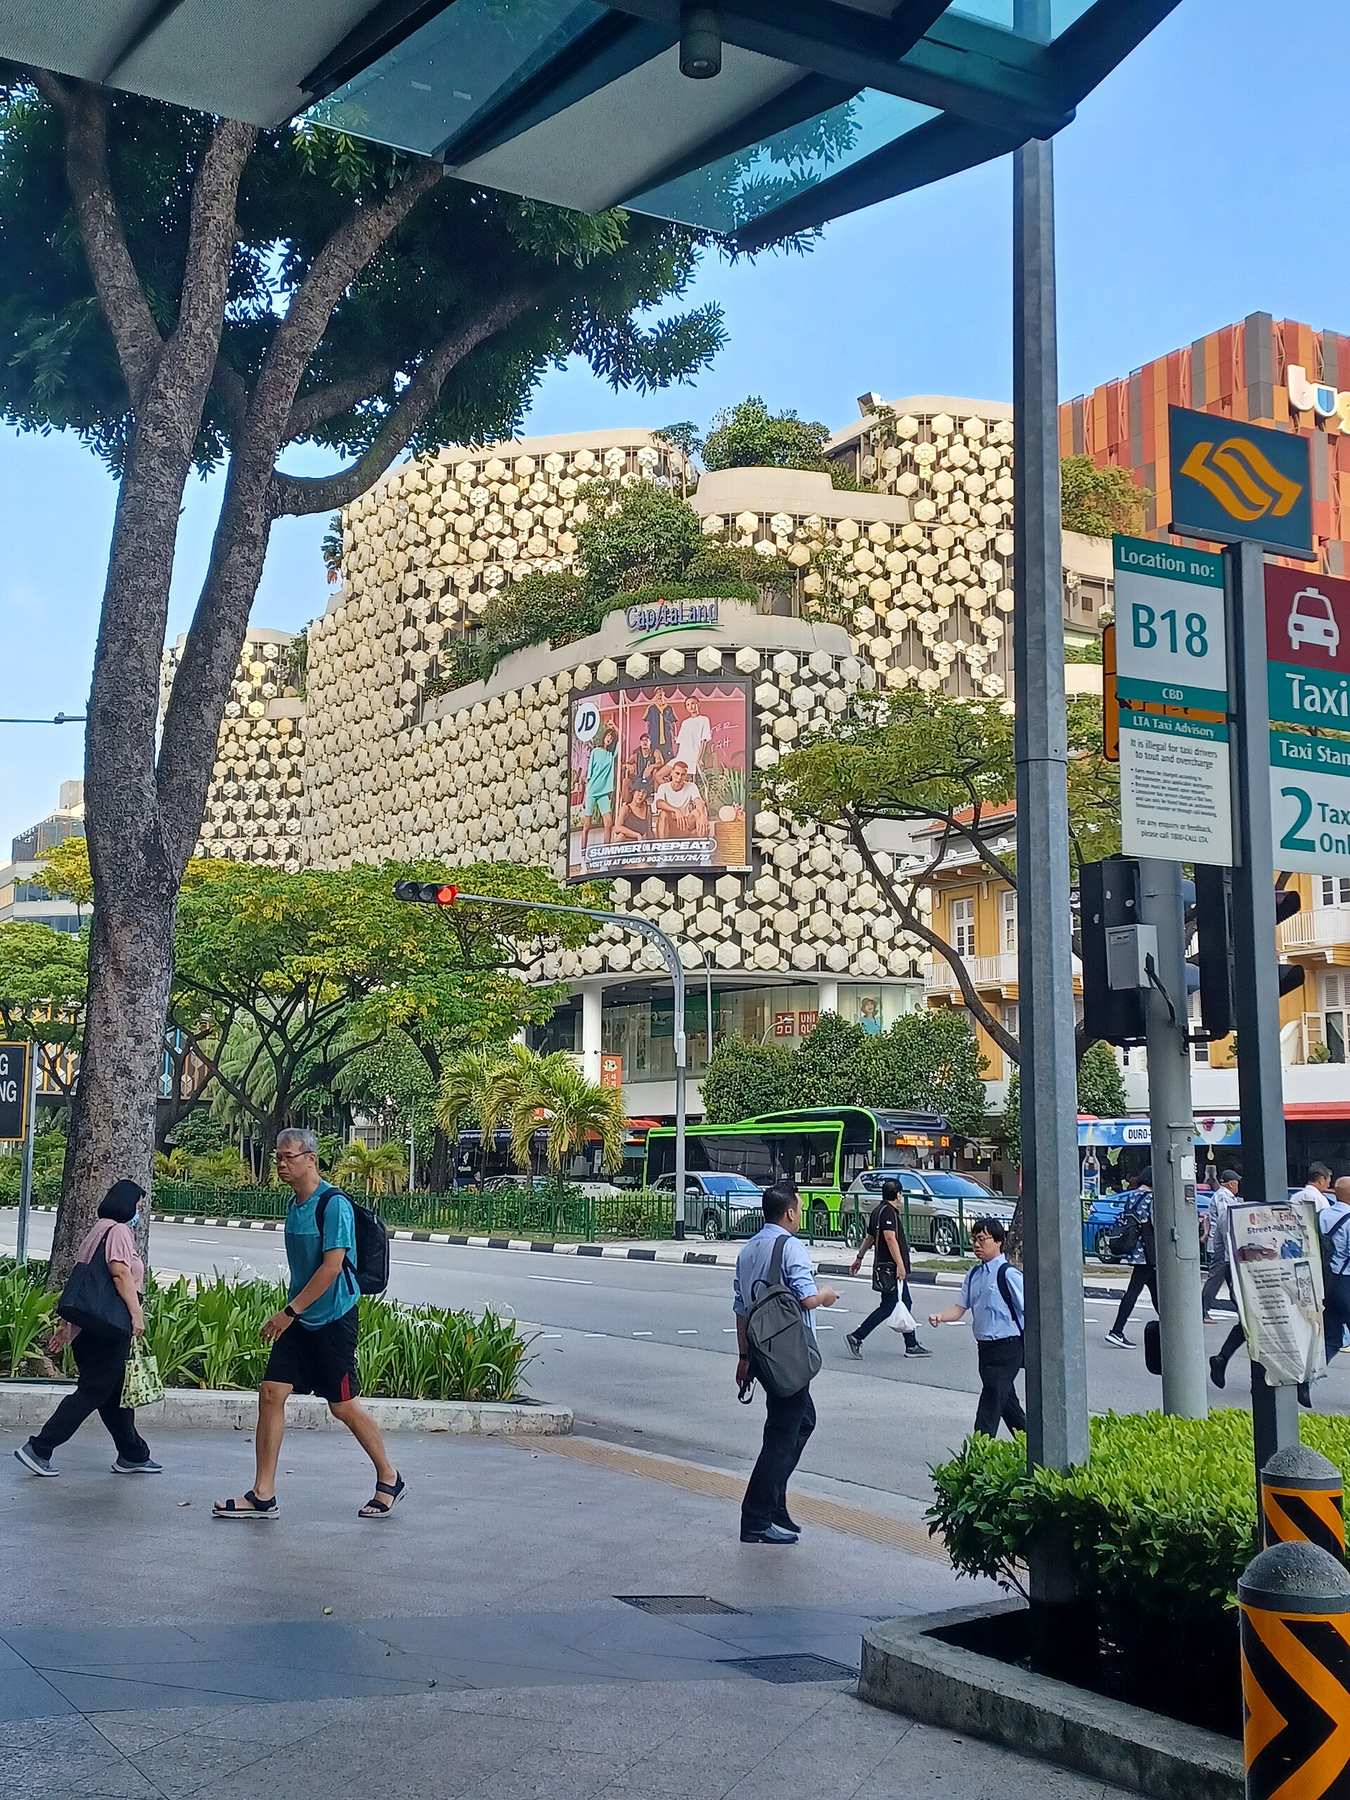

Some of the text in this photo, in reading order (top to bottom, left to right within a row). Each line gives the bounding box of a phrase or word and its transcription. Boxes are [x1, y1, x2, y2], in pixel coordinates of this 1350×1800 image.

[1120, 546, 1215, 578] Location no:
[625, 598, 719, 632] CapitaLand
[1132, 603, 1209, 657] B18
[1162, 687, 1184, 701] CBD
[1285, 672, 1349, 717] Taxi
[577, 711, 597, 733] JD
[1132, 715, 1215, 739] LTA Taxi Advisory
[1135, 751, 1144, 760] to
[1161, 754, 1175, 764] and
[1145, 740, 1167, 753] illegal
[1168, 743, 1178, 753] for
[1279, 739, 1313, 761] Taxi
[1280, 786, 1316, 852] 2
[588, 844, 642, 857] SUMMER
[651, 841, 711, 852] REPEAT
[612, 858, 622, 866] AT
[800, 1013, 816, 1023] UNI
[940, 1135, 950, 1147] 61
